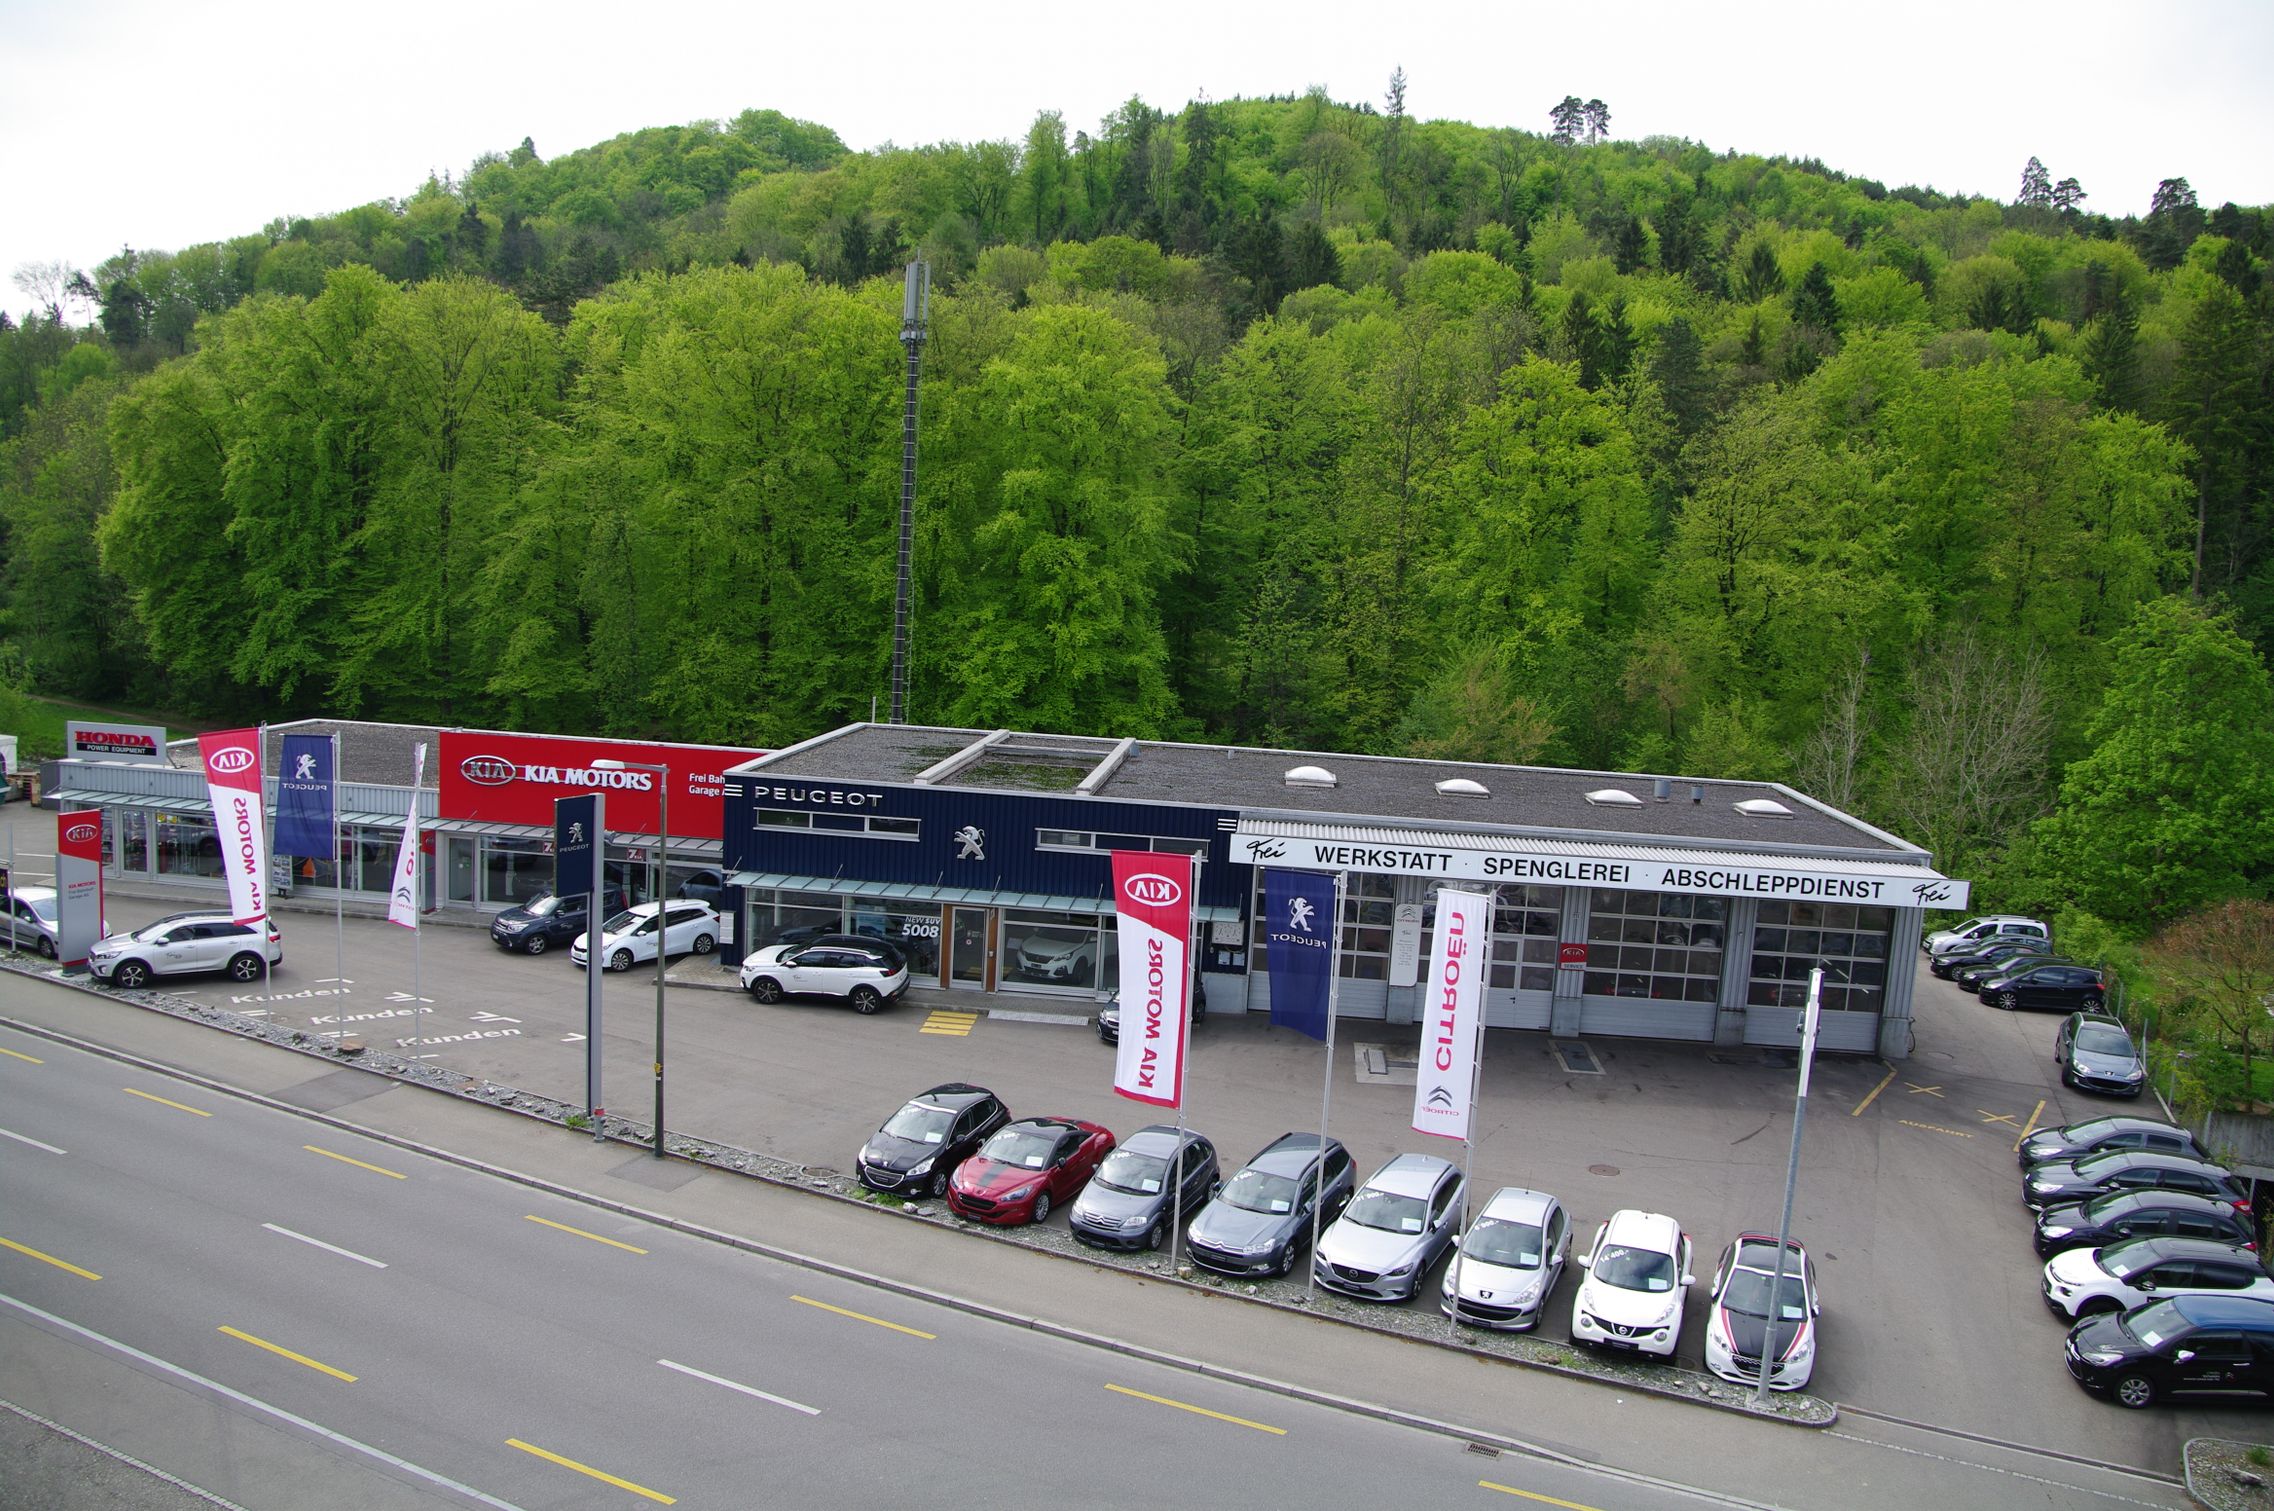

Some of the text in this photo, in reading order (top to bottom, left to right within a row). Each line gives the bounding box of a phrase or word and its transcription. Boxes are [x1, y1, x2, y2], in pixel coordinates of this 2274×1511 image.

[75, 731, 157, 747] HONDA
[87, 744, 146, 754] POWER EQUIPMENT
[469, 761, 652, 791] KIA KIA MOTORS
[689, 773, 707, 783] Frei
[689, 785, 720, 797] Garage
[754, 786, 883, 807] PEUGEOT
[559, 843, 590, 853] PEUGEOT
[1246, 838, 1951, 906] Frei WERKSTATT SPENGLEREI ABSCHLEPPDIENST Frei
[905, 916, 924, 924] NEW
[901, 923, 940, 938] 5008
[231, 988, 351, 1003] Kunden
[311, 1007, 435, 1025] Kunden
[396, 1028, 522, 1048] Kunden
